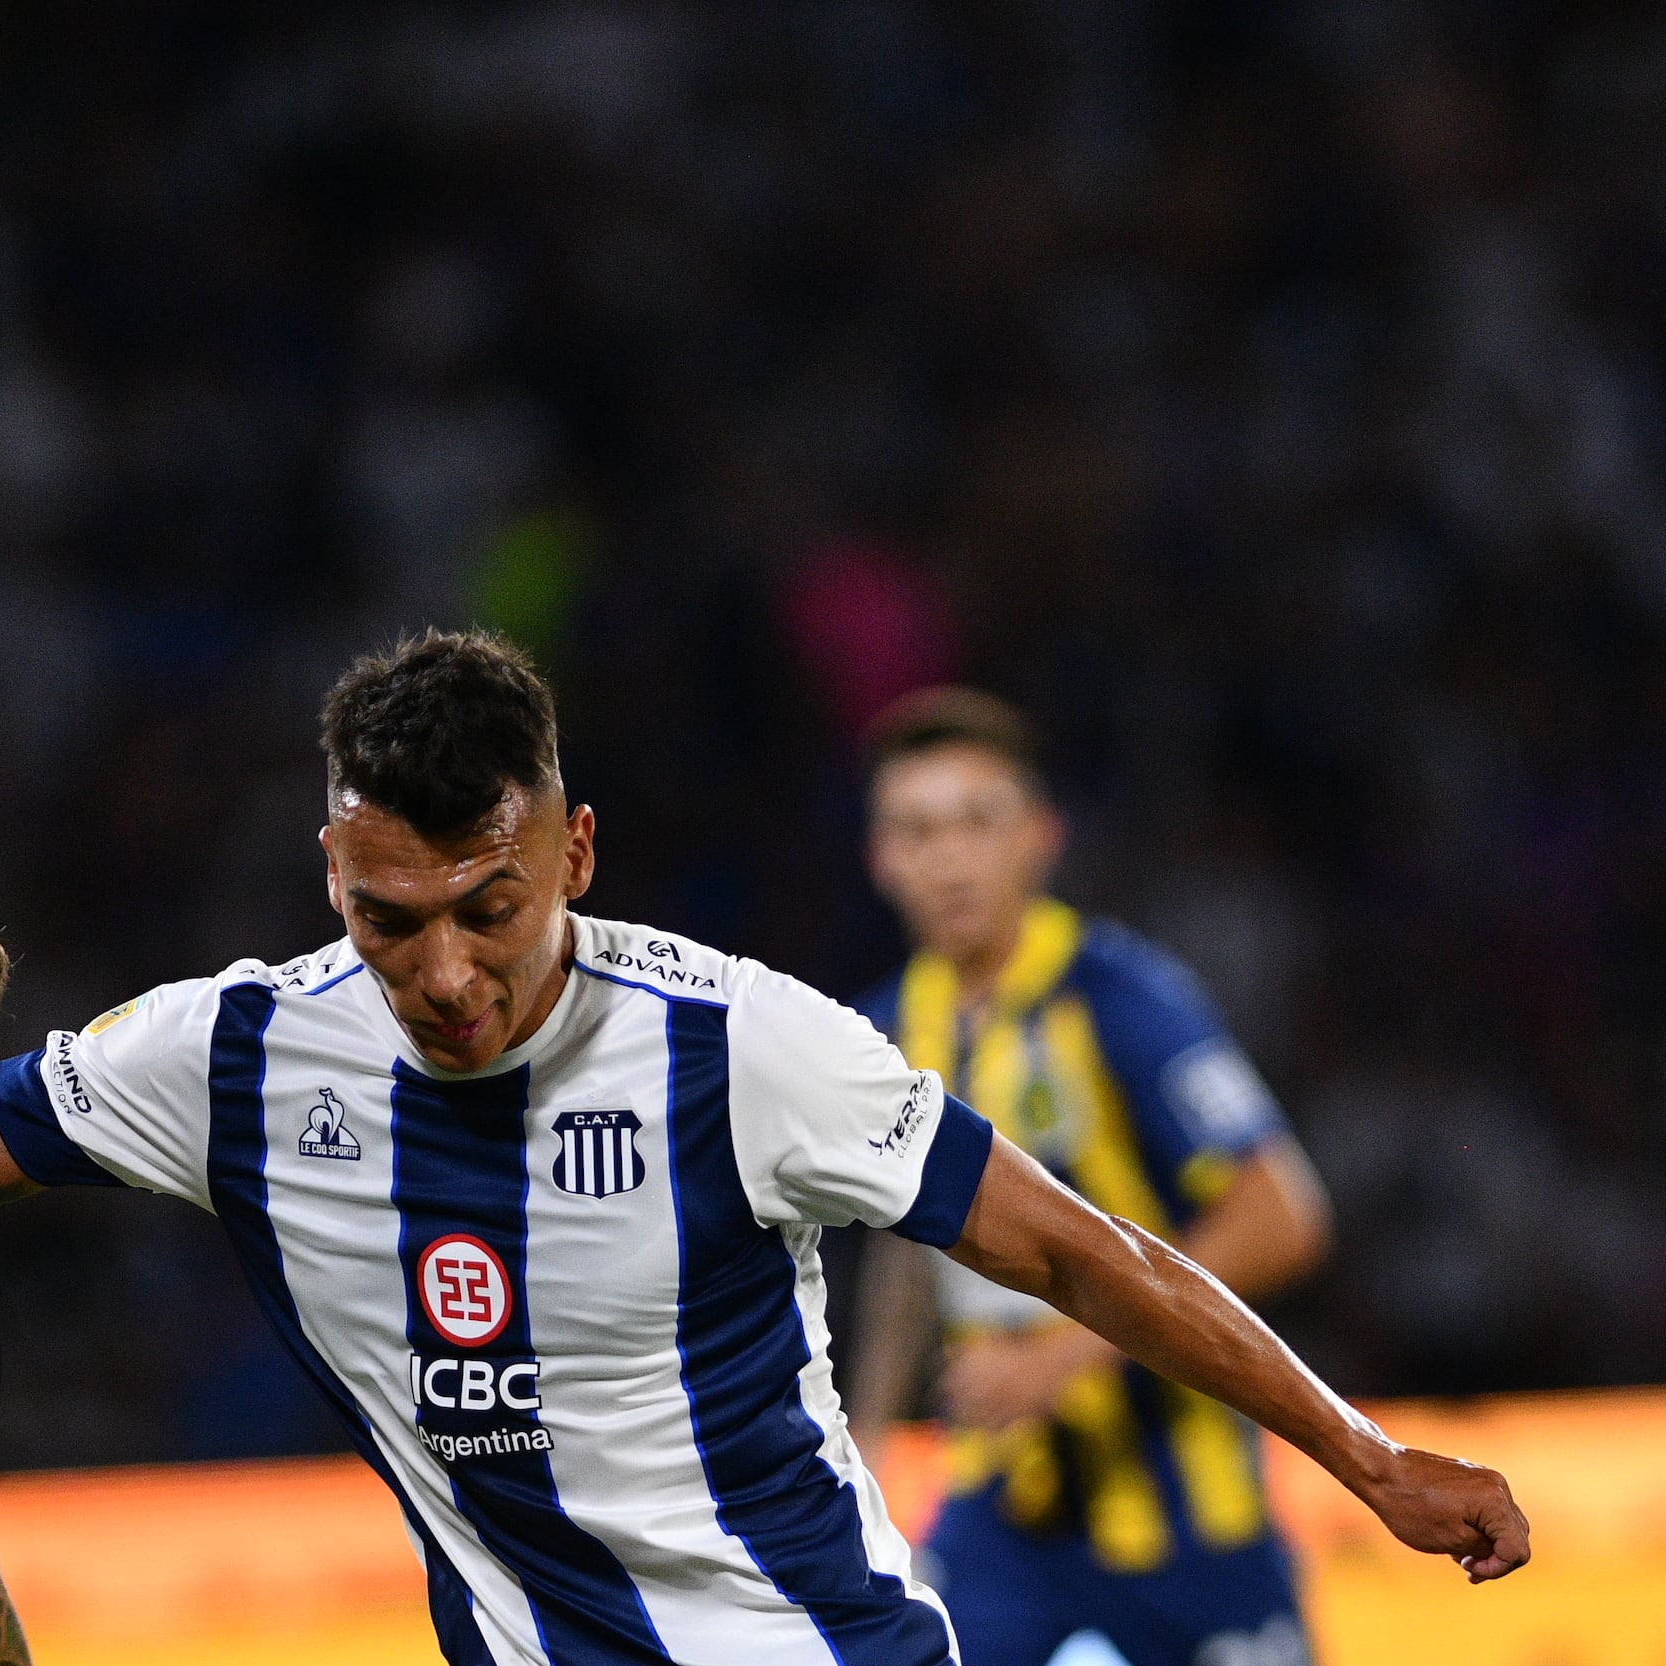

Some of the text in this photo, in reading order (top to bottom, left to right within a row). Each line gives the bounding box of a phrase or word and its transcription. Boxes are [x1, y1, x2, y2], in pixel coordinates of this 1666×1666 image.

[594, 950, 716, 989] ADVANTA
[573, 1113, 620, 1126] C.A.T
[897, 1109, 928, 1159] GLOBAL
[300, 1142, 360, 1159] LE COQ SPORTIF
[410, 1354, 541, 1411] ICBC
[418, 1423, 553, 1462] Argentina
